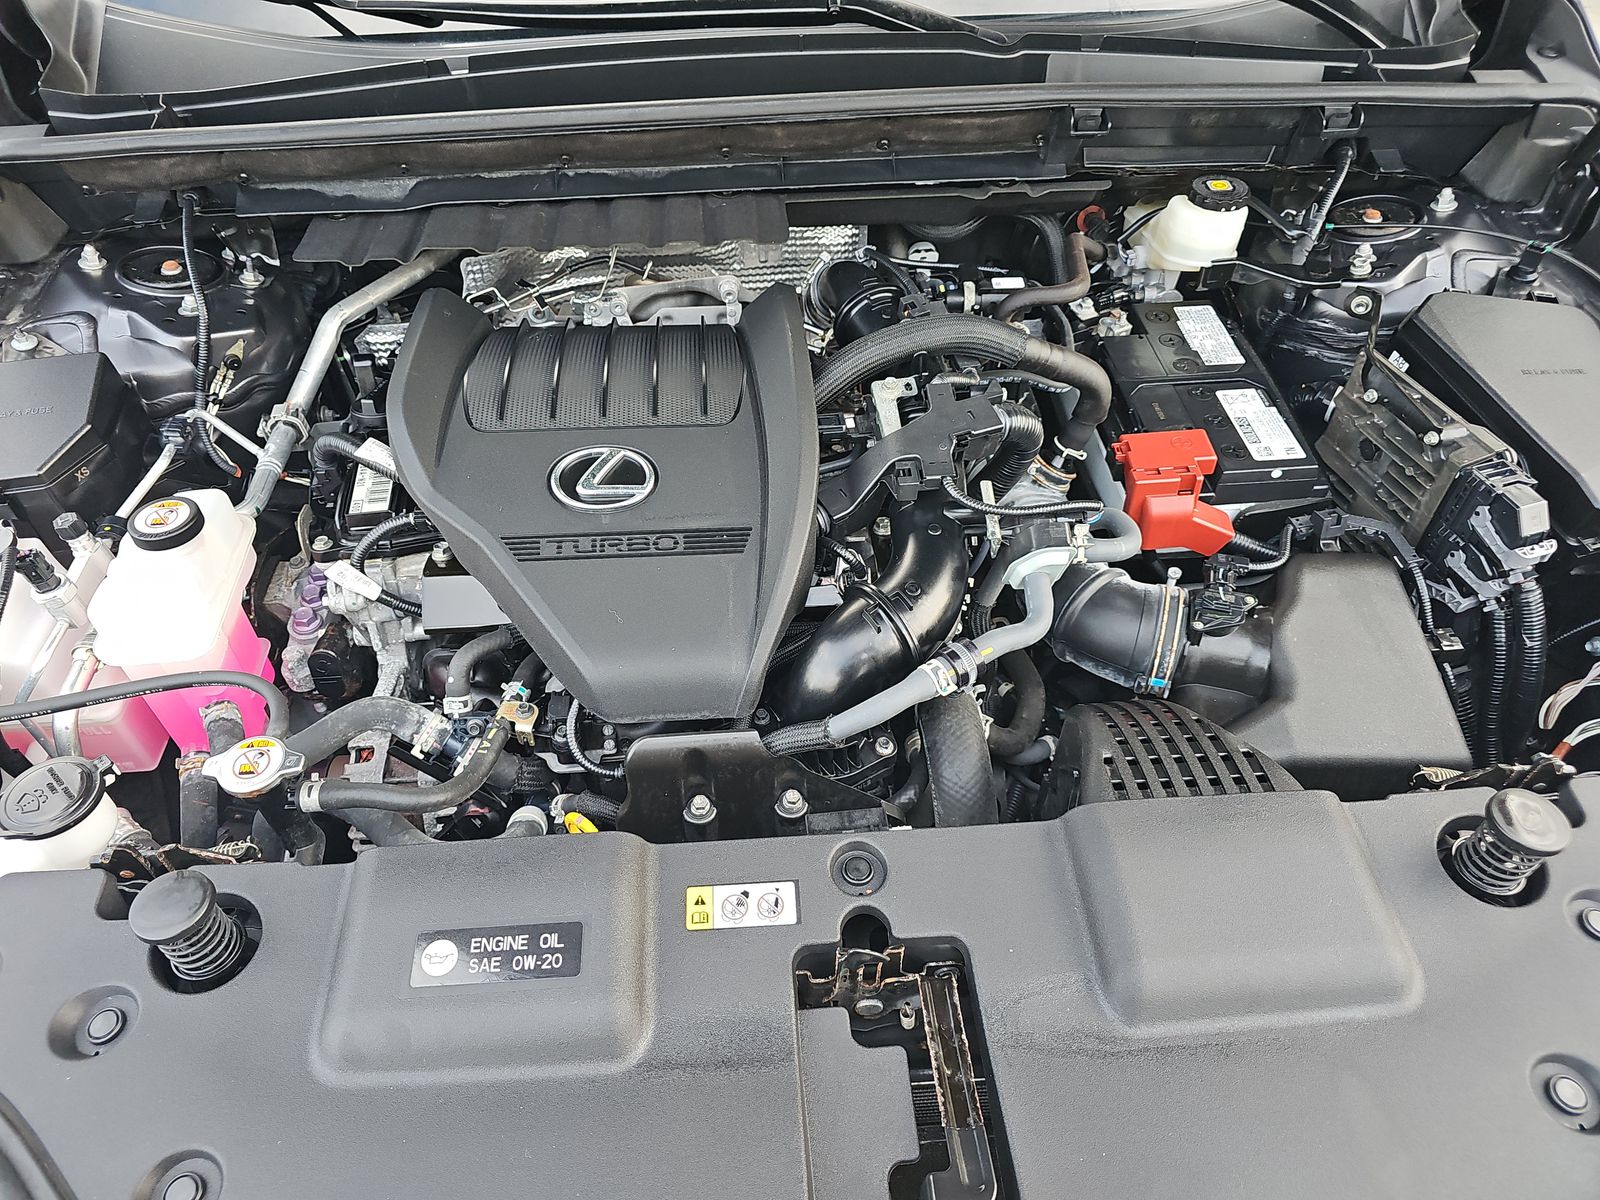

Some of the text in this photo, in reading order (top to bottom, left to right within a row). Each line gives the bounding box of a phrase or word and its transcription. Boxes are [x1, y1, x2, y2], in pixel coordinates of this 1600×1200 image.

[74, 466, 90, 482] XS
[545, 533, 680, 555] TURBO
[470, 932, 565, 953] ENGINE OIL
[468, 952, 563, 974] SAE 0W-20
